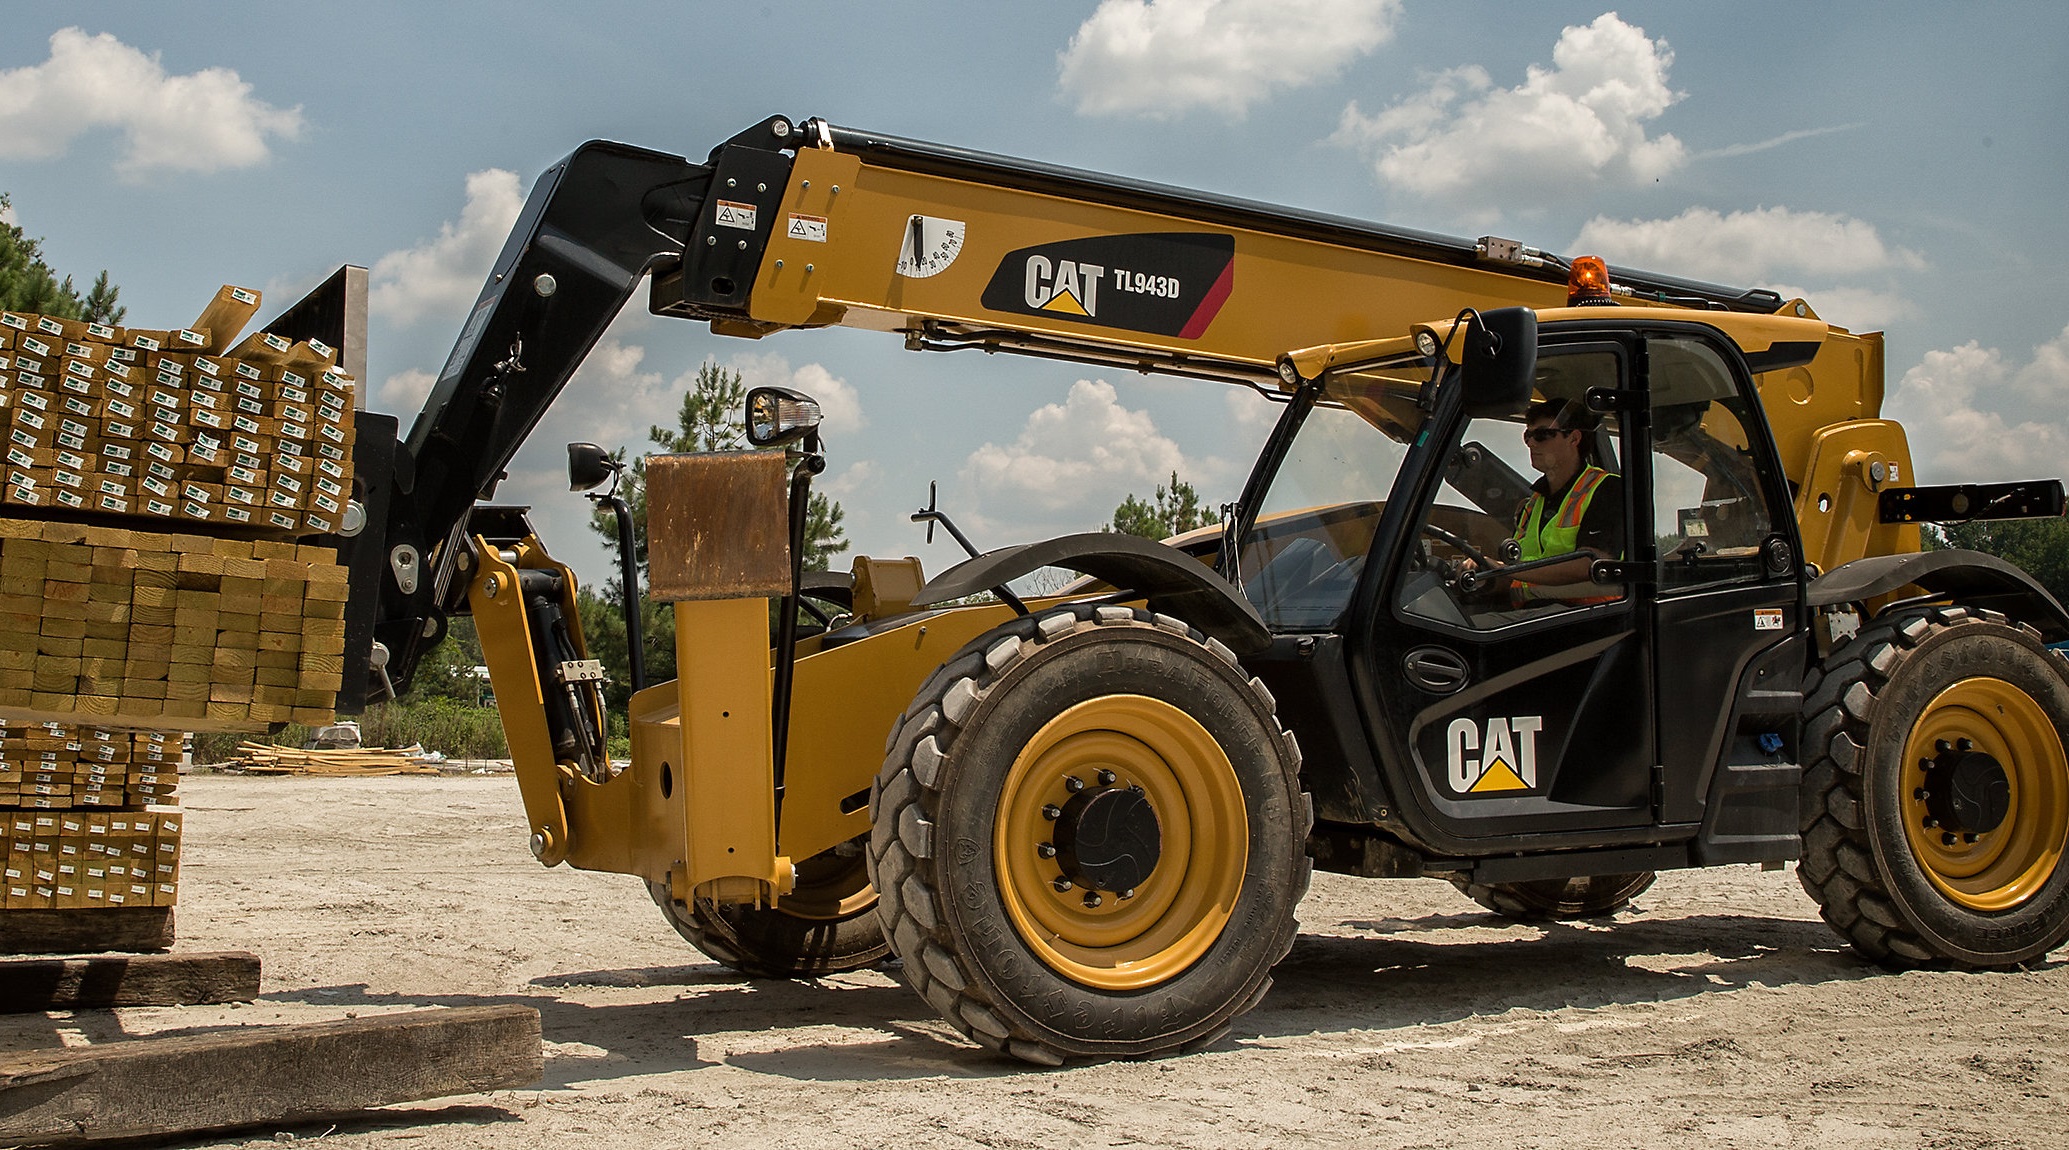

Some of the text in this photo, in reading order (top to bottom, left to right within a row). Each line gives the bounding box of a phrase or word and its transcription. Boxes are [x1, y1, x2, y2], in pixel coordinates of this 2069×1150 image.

[909, 257, 914, 266] 0
[929, 260, 936, 269] 30
[1025, 254, 1180, 317] CAT TL943D
[1447, 716, 1542, 793] CAT
